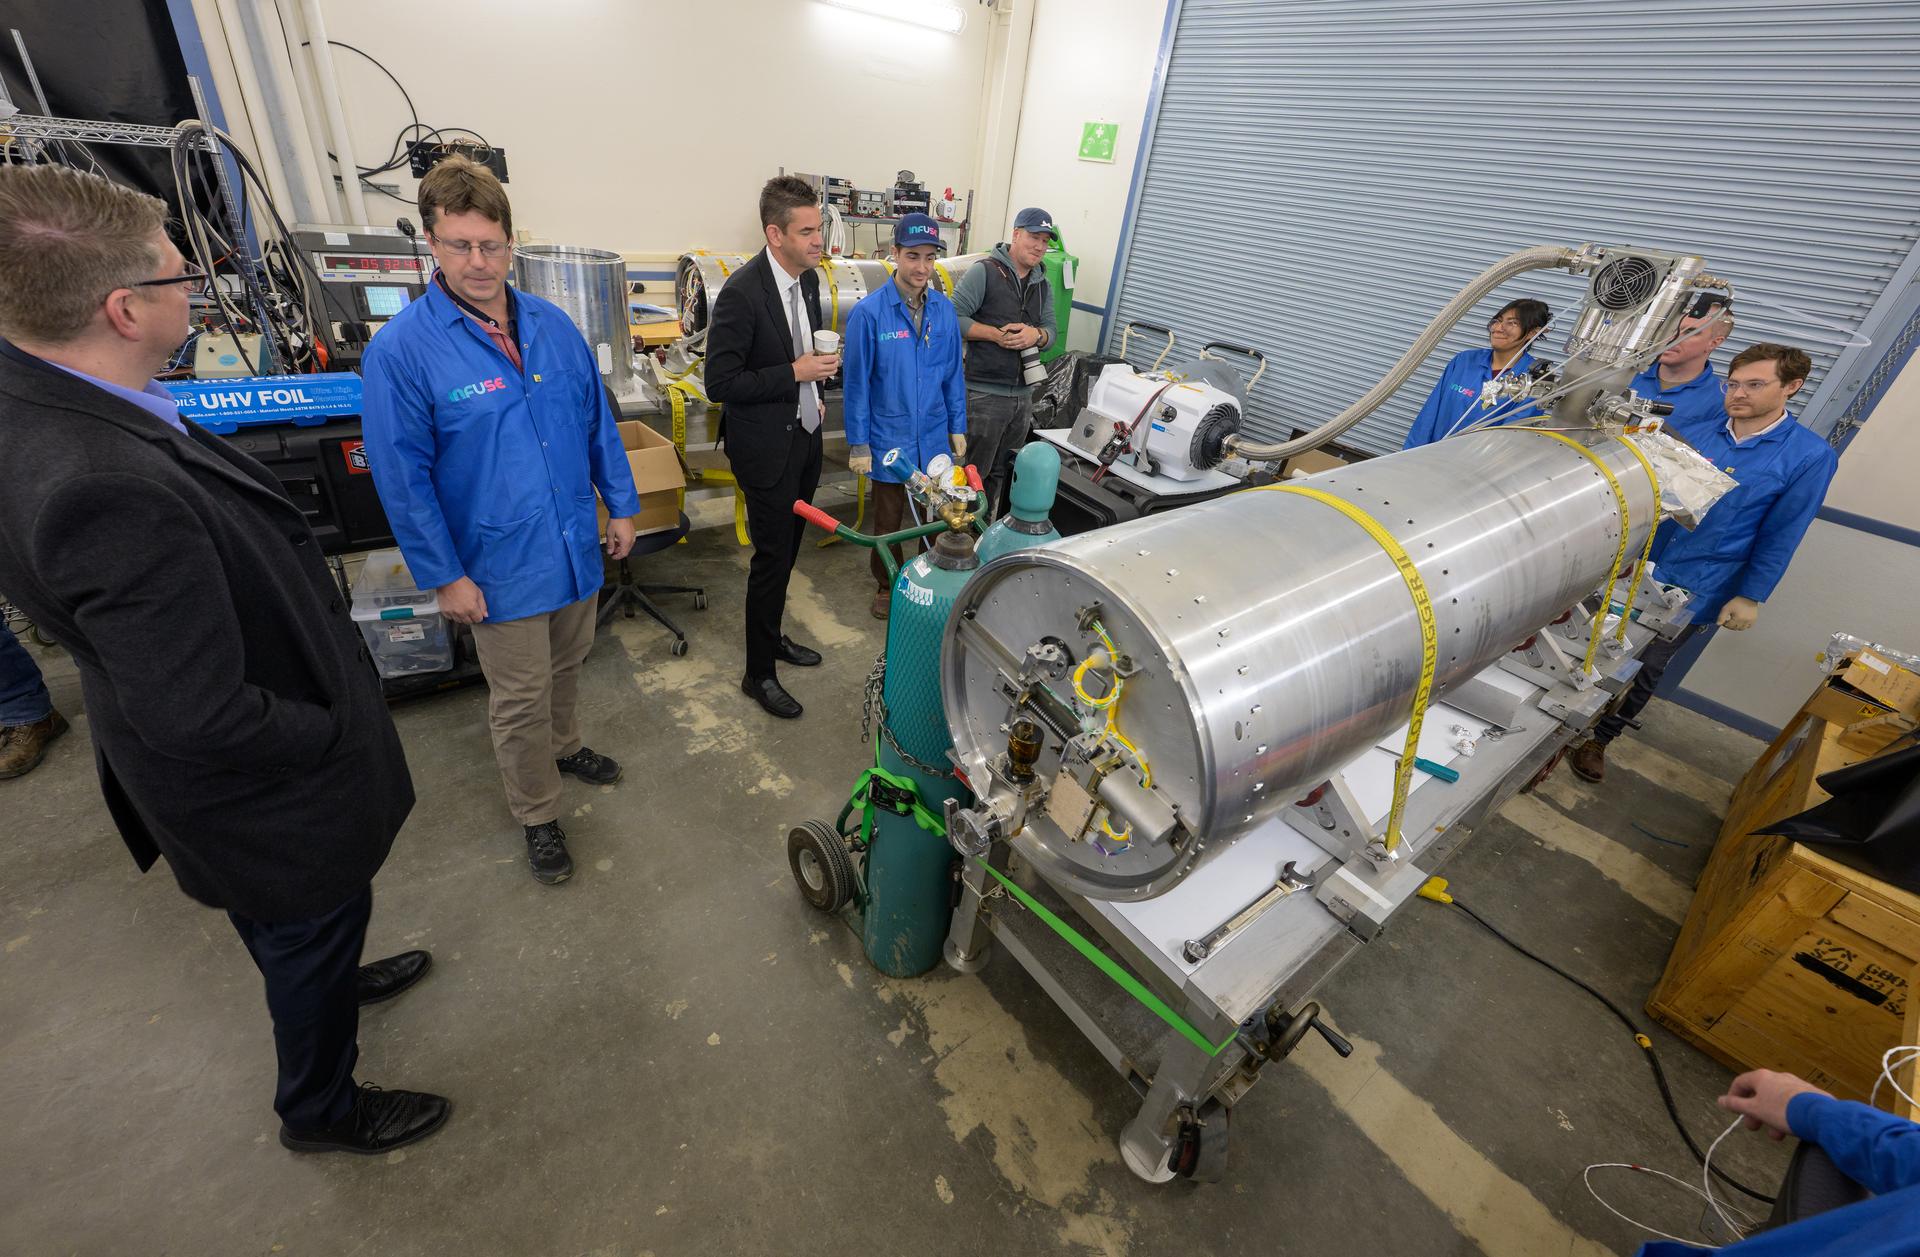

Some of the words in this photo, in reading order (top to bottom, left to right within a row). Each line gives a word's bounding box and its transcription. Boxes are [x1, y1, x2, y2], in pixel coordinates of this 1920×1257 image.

[199, 391, 252, 409] UHV
[257, 388, 314, 406] FOIL
[1409, 574, 1436, 679] HUGGER
[1408, 686, 1428, 747] LOAD
